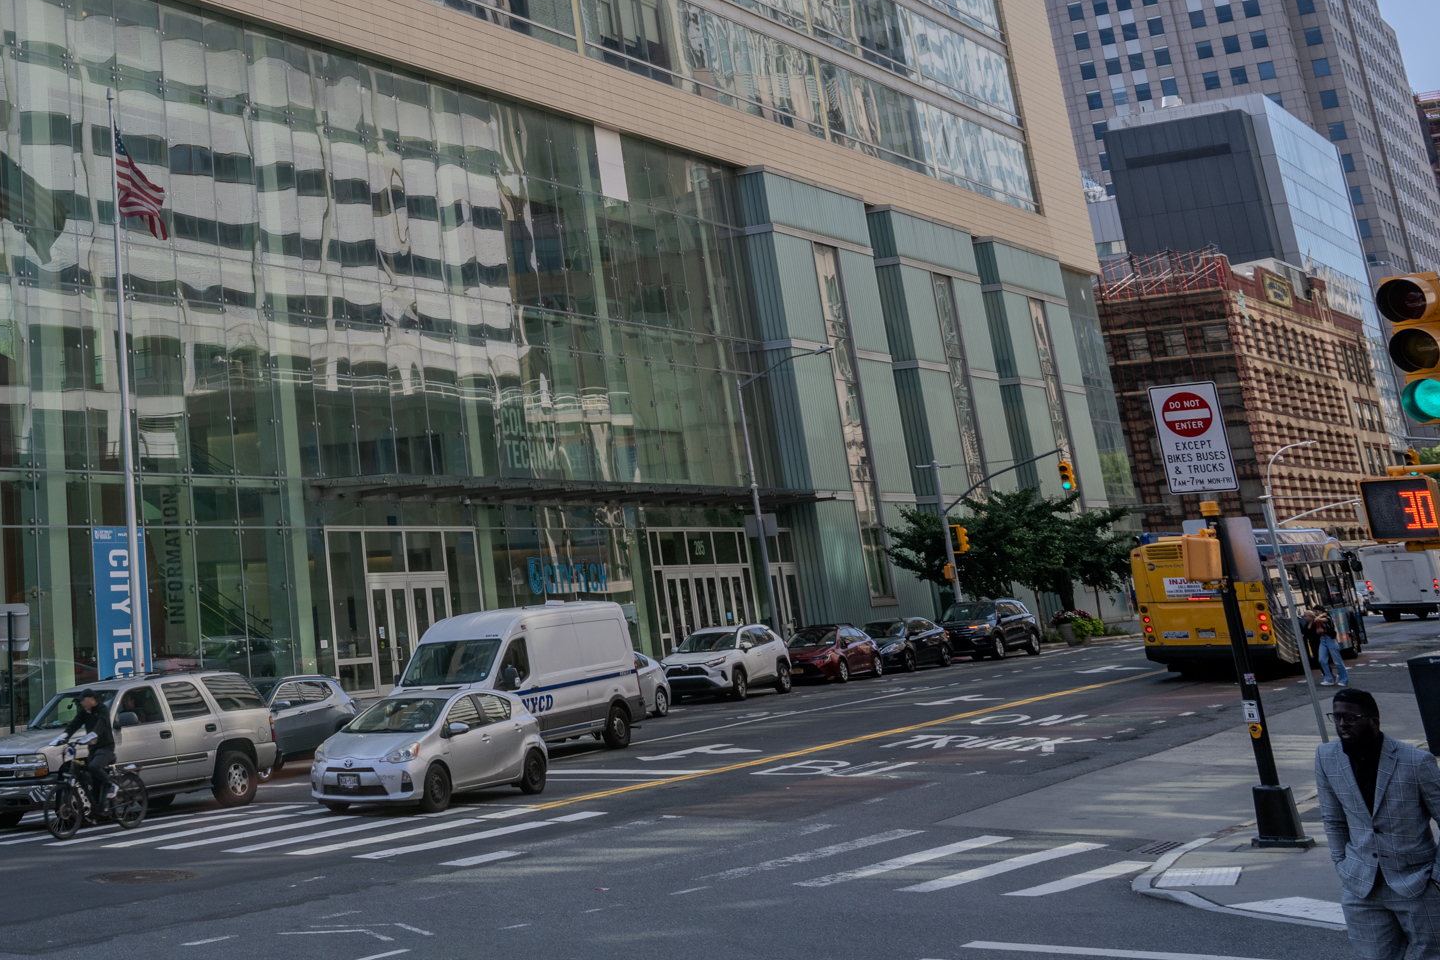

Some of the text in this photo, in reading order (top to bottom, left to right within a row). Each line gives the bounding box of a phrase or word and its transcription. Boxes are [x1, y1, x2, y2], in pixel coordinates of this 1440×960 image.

[1169, 399, 1200, 409] DO NOT
[1175, 420, 1204, 430] ENTER
[1175, 440, 1211, 451] EXCEPT
[1167, 451, 1226, 463] BIKES BUSES
[1175, 463, 1225, 475] & TRUCKS
[1207, 477, 1233, 485] MON-FRI
[1398, 490, 1439, 530] 30
[162, 492, 185, 625] INFORMATION
[108, 548, 131, 615] CITY
[544, 565, 573, 595] CITY
[112, 623, 135, 679] TEC
